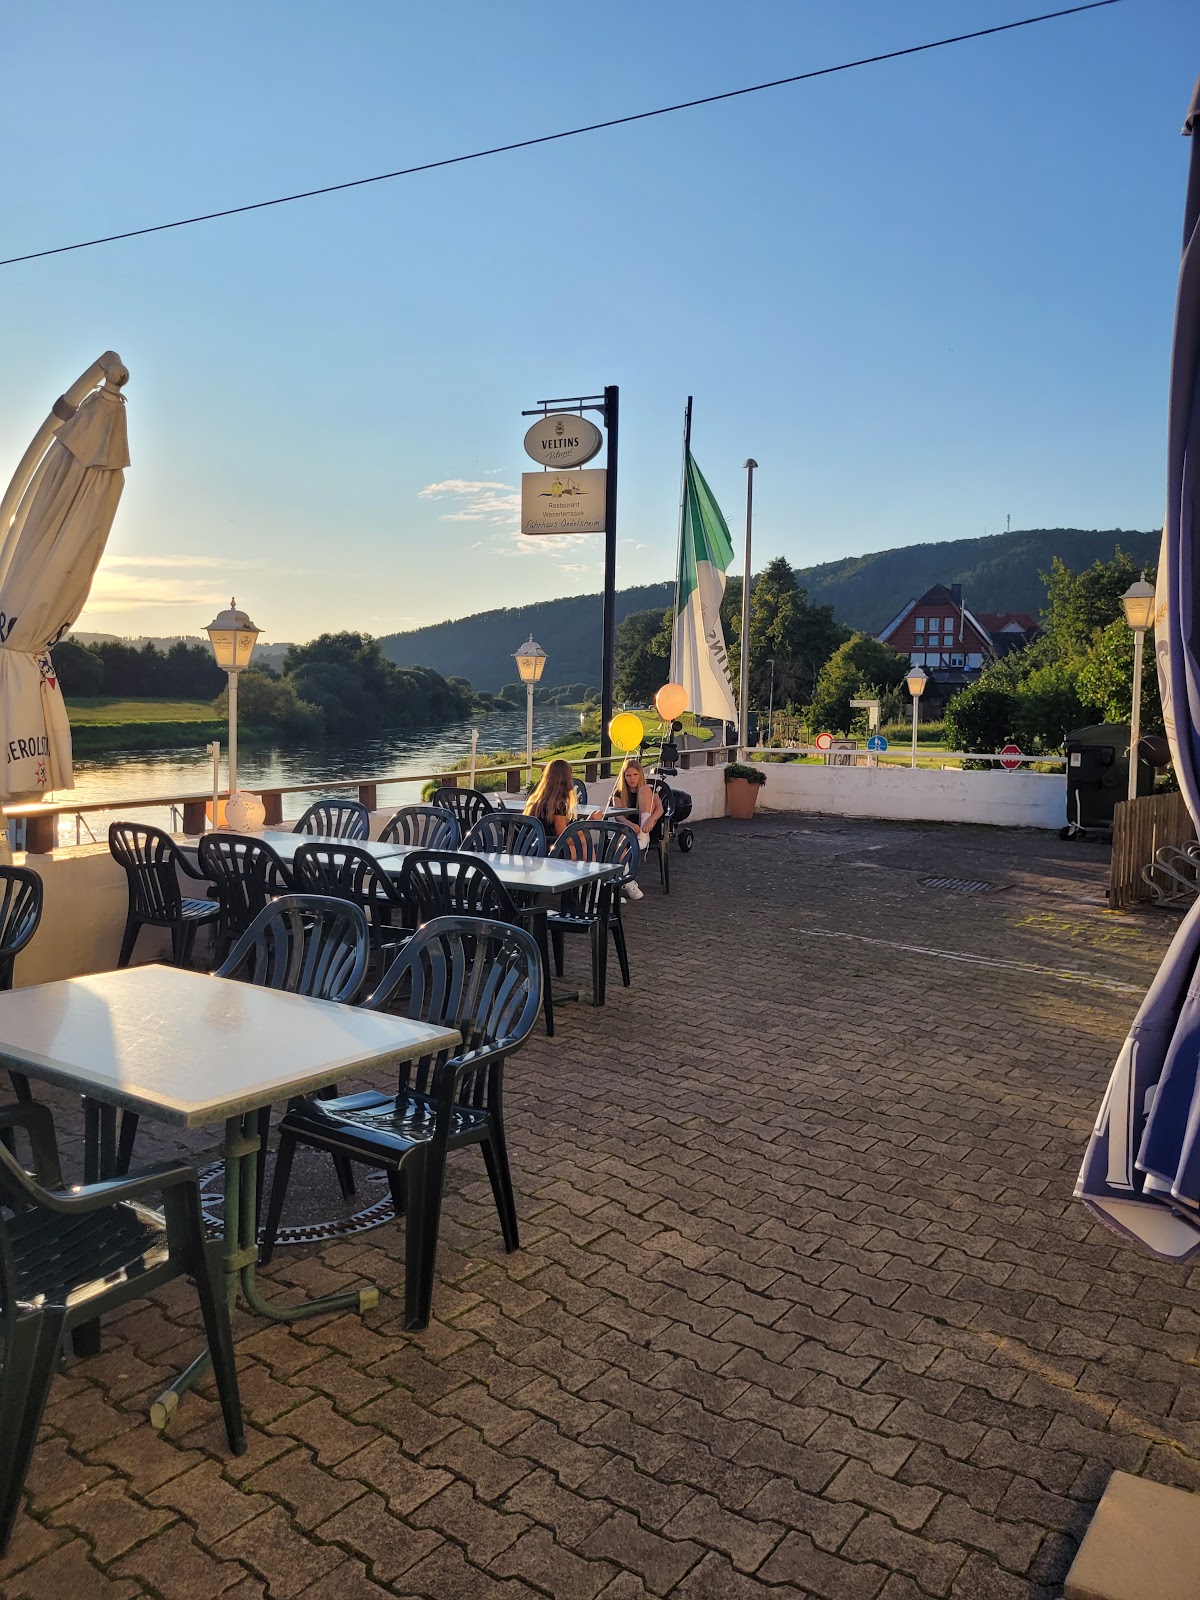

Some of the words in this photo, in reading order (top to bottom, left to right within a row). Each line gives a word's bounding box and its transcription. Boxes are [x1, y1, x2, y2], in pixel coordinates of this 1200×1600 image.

[542, 438, 579, 449] VELTINS
[548, 501, 580, 509] Restaurant
[560, 518, 600, 528] Oedelsheim
